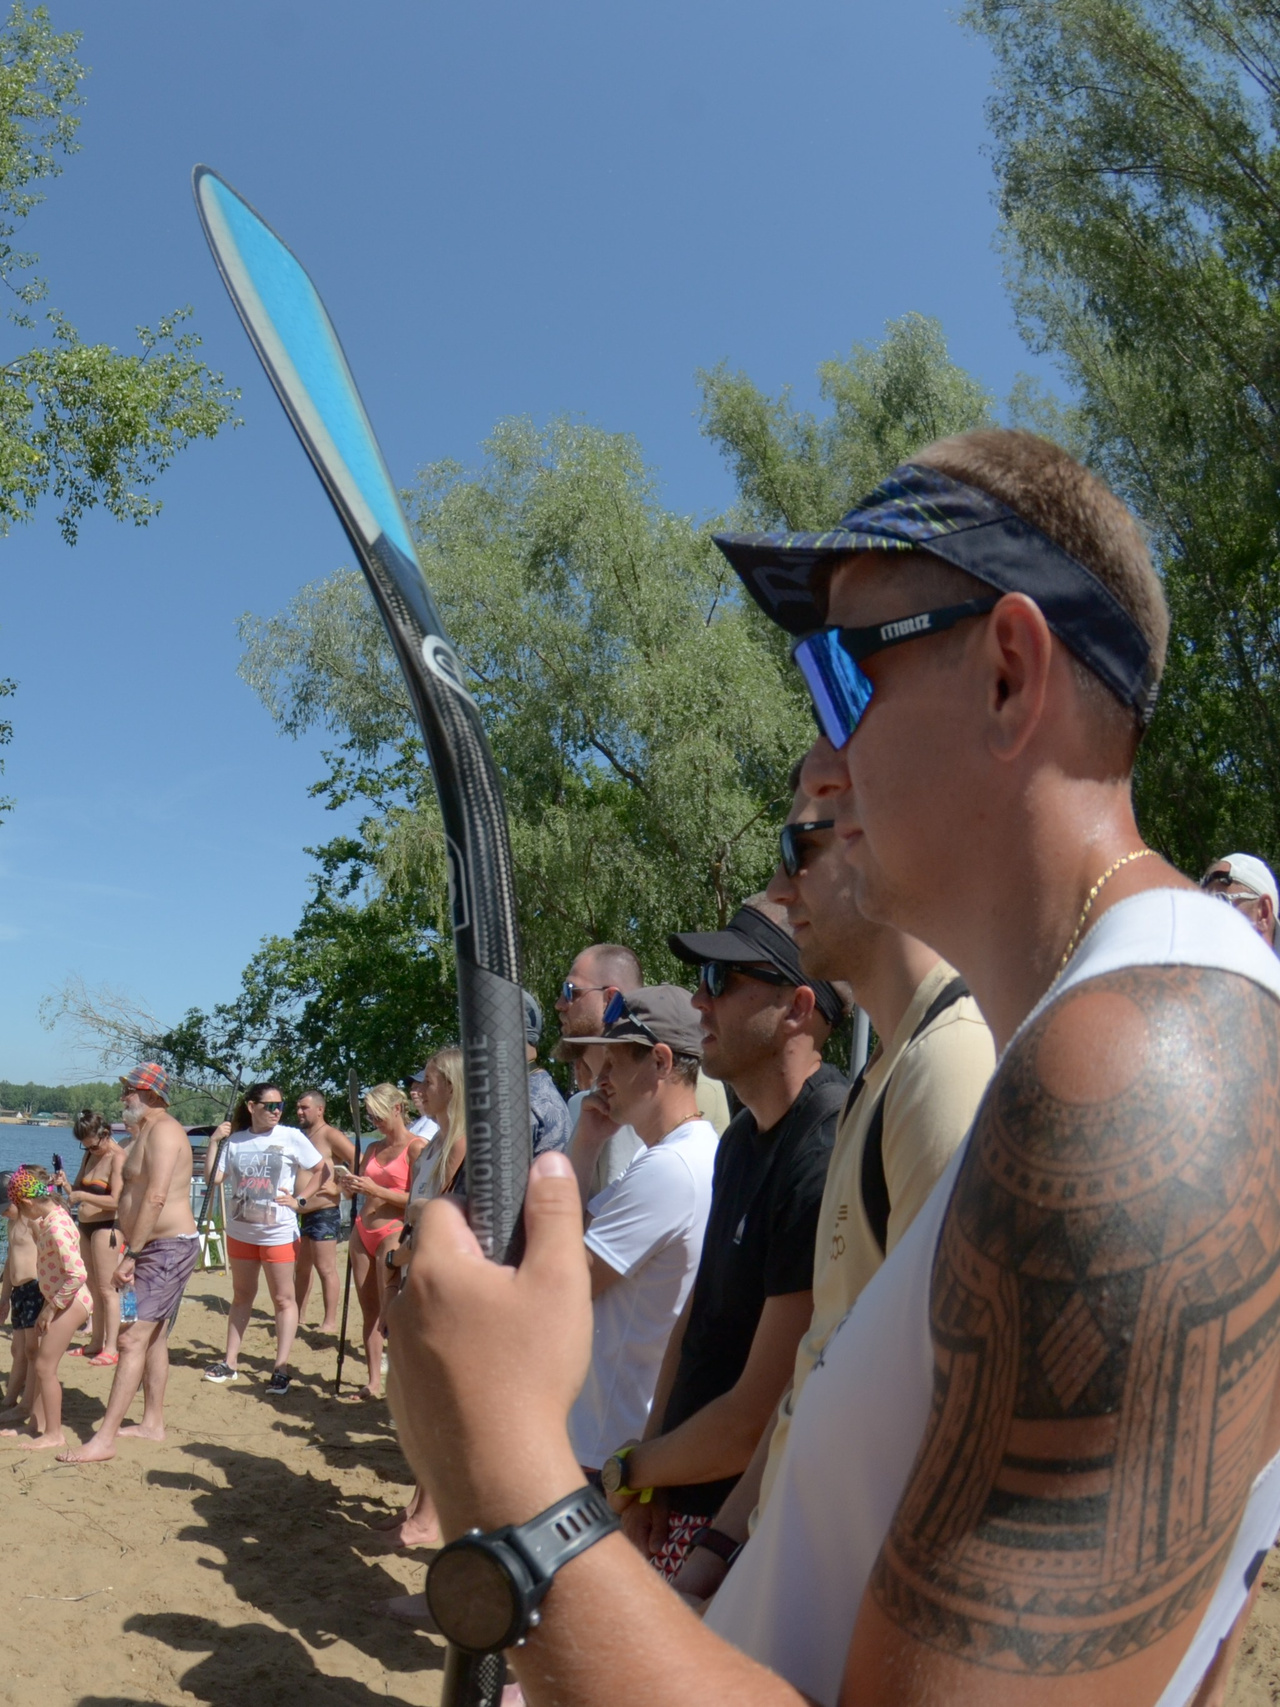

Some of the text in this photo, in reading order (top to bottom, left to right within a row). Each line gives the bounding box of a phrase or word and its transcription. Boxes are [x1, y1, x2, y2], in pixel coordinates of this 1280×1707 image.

[468, 1033, 492, 1111] ELITE
[496, 1040, 512, 1135] CONSTRUCTION
[238, 1153, 272, 1166] EAT
